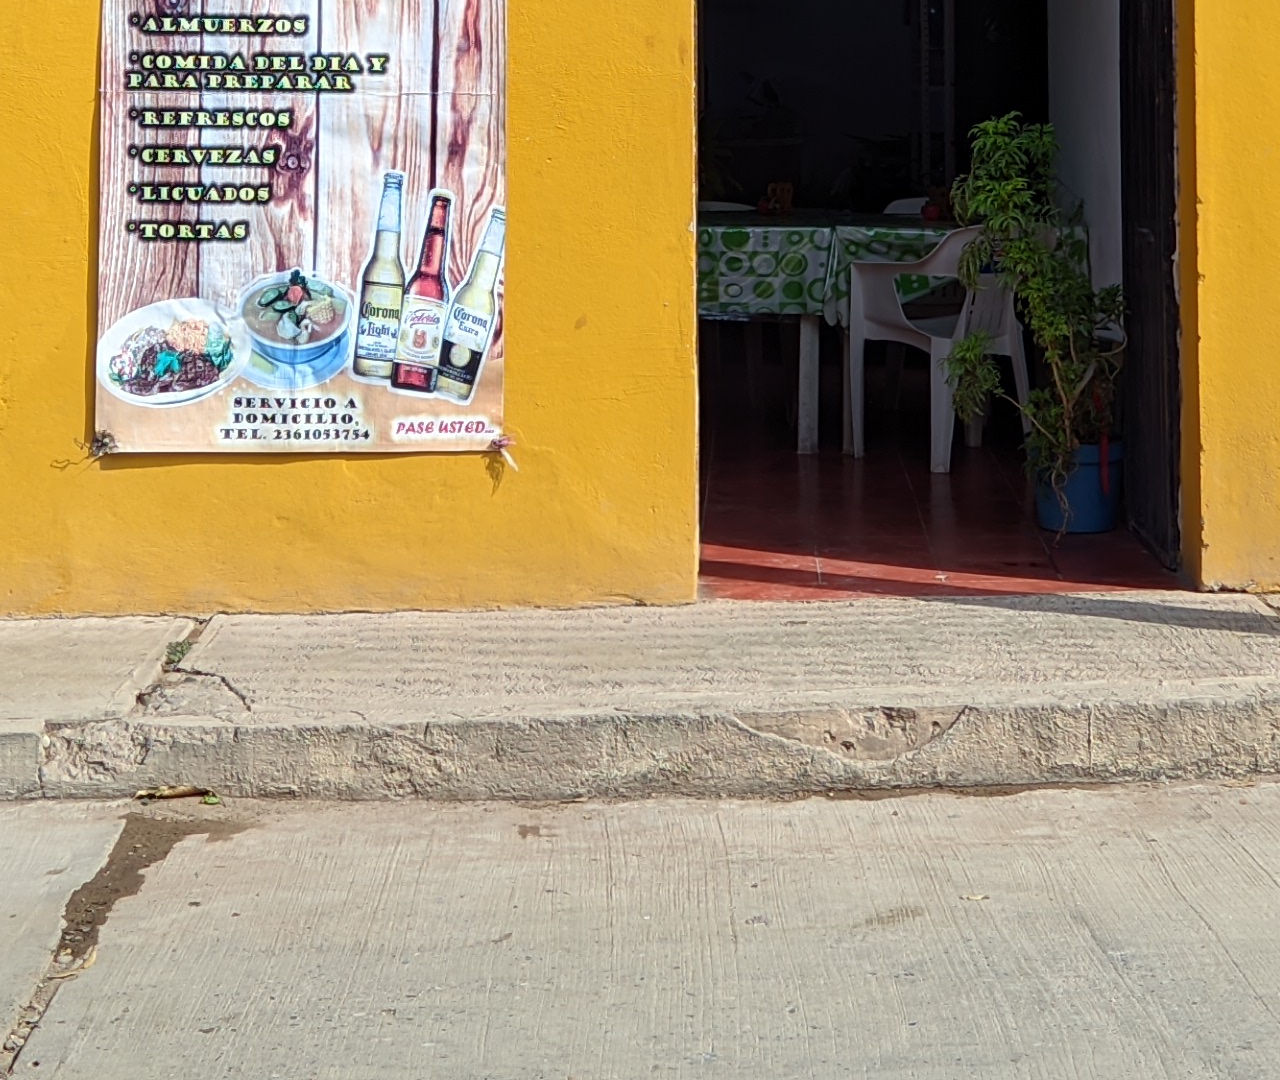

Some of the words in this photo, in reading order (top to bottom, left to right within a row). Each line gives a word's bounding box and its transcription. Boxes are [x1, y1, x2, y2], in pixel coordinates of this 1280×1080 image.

[255, 56, 304, 70] DEL
[312, 56, 359, 71] DIA
[370, 57, 387, 71] Y
[127, 73, 198, 89] PARA
[207, 73, 352, 90] PREPARAR
[362, 302, 400, 320] Corona
[453, 307, 488, 332] Corona
[366, 322, 390, 338] Light
[233, 397, 336, 409] SERVICIO
[344, 397, 358, 409] A
[232, 413, 359, 426] DOMICILIO,
[220, 428, 267, 440] TEL.
[273, 428, 370, 441] 2361053754
[396, 421, 434, 434] PASE
